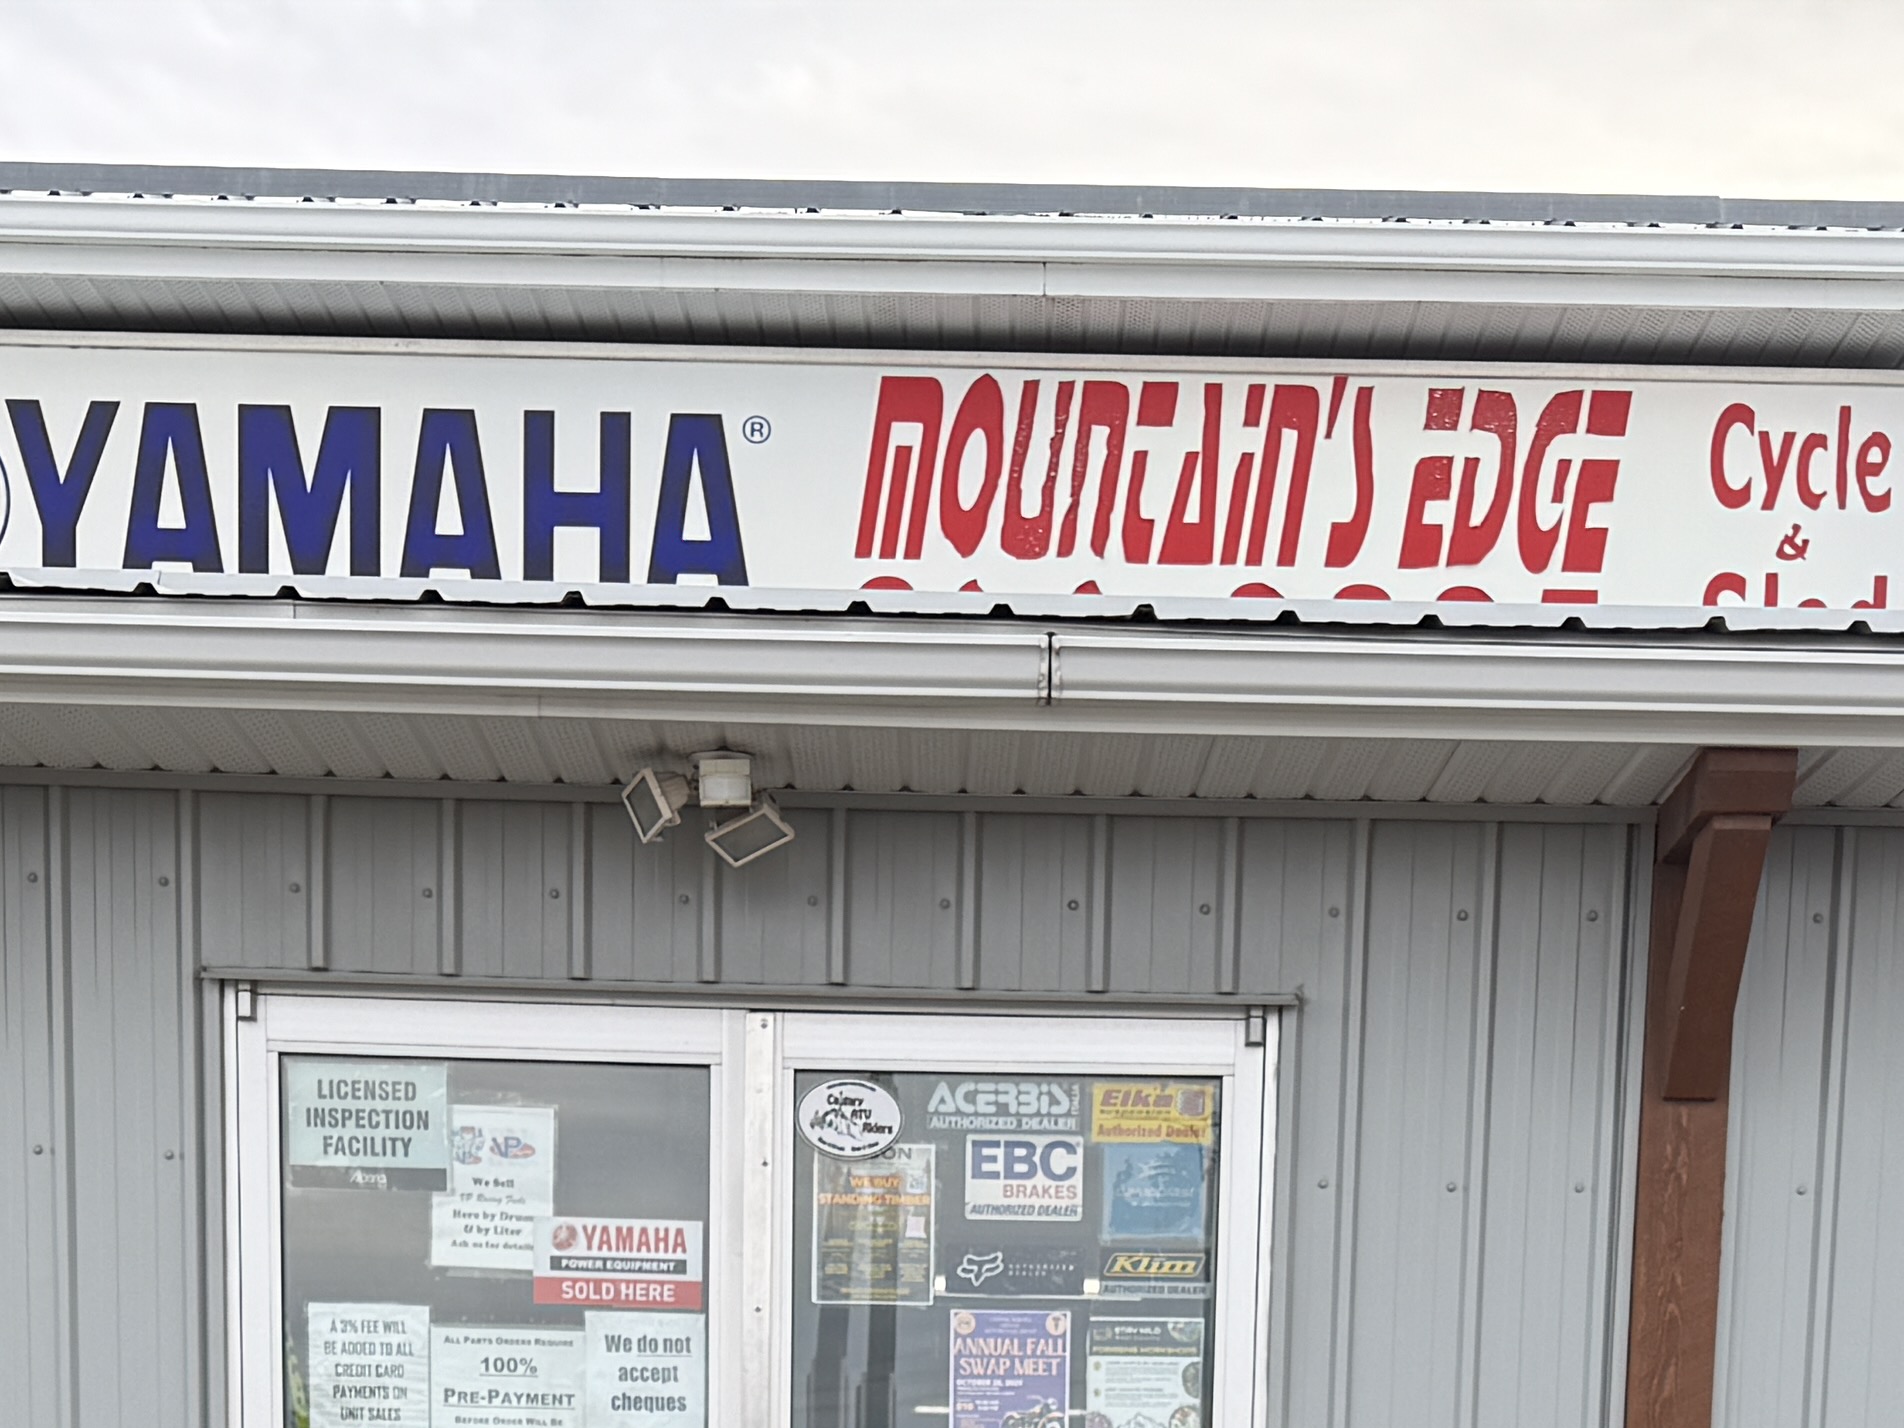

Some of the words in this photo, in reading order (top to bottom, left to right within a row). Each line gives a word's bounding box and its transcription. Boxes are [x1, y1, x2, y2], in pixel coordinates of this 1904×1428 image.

[1707, 403, 1893, 511] Cycle
[854, 373, 1375, 570] MOUNTAIN'S
[1398, 386, 1632, 574] EDGE
[5, 399, 749, 586] YAMAHA
[1775, 523, 1809, 561] &
[317, 1079, 417, 1101] LICENSED
[928, 1082, 1070, 1114] ACERBIS
[306, 1107, 429, 1130] INSPECTION
[929, 1116, 1017, 1129] AUTHORIZED
[1021, 1116, 1076, 1130] DEALER
[862, 1122, 893, 1135] Riders
[1097, 1123, 1162, 1138] Authorized
[1166, 1124, 1206, 1138] Dealer
[323, 1135, 412, 1158] FACILITY
[971, 1139, 1078, 1182] EBC
[850, 1176, 871, 1188] WE
[1003, 1185, 1077, 1200] BRAKES
[969, 1203, 1035, 1216] AUTHORIZED
[1037, 1204, 1078, 1217] DEALER
[582, 1224, 687, 1254] YAMAHA
[561, 1258, 603, 1269] POWER
[606, 1259, 676, 1271] EQUIPMENT
[562, 1281, 614, 1300] SOLD
[621, 1283, 675, 1302] HERE
[1103, 1283, 1165, 1294] AUTHORIZED
[1167, 1284, 1207, 1295] DEALER
[330, 1318, 338, 1333] A
[340, 1319, 358, 1333] 3%
[361, 1320, 380, 1333] FEE
[382, 1321, 407, 1334] WILL
[324, 1341, 337, 1355] BE
[340, 1341, 376, 1356] ADDED
[380, 1342, 393, 1356] TO
[395, 1343, 415, 1356] ALL
[605, 1334, 632, 1353] We
[637, 1334, 658, 1353] do
[663, 1336, 691, 1354] not
[954, 1338, 1023, 1356] ANNUAL
[1026, 1338, 1069, 1357] FALL
[335, 1363, 372, 1378] CREDIT
[375, 1364, 405, 1378] CARD
[480, 1357, 538, 1375] 100%
[618, 1366, 678, 1384] accept
[959, 1357, 1011, 1376] SWAP
[1014, 1358, 1061, 1376] MEET
[333, 1384, 390, 1399] PAYMENTS
[392, 1386, 408, 1400] ON
[611, 1391, 687, 1413] cheques
[340, 1406, 365, 1421] UNIT
[368, 1407, 402, 1421] SALES
